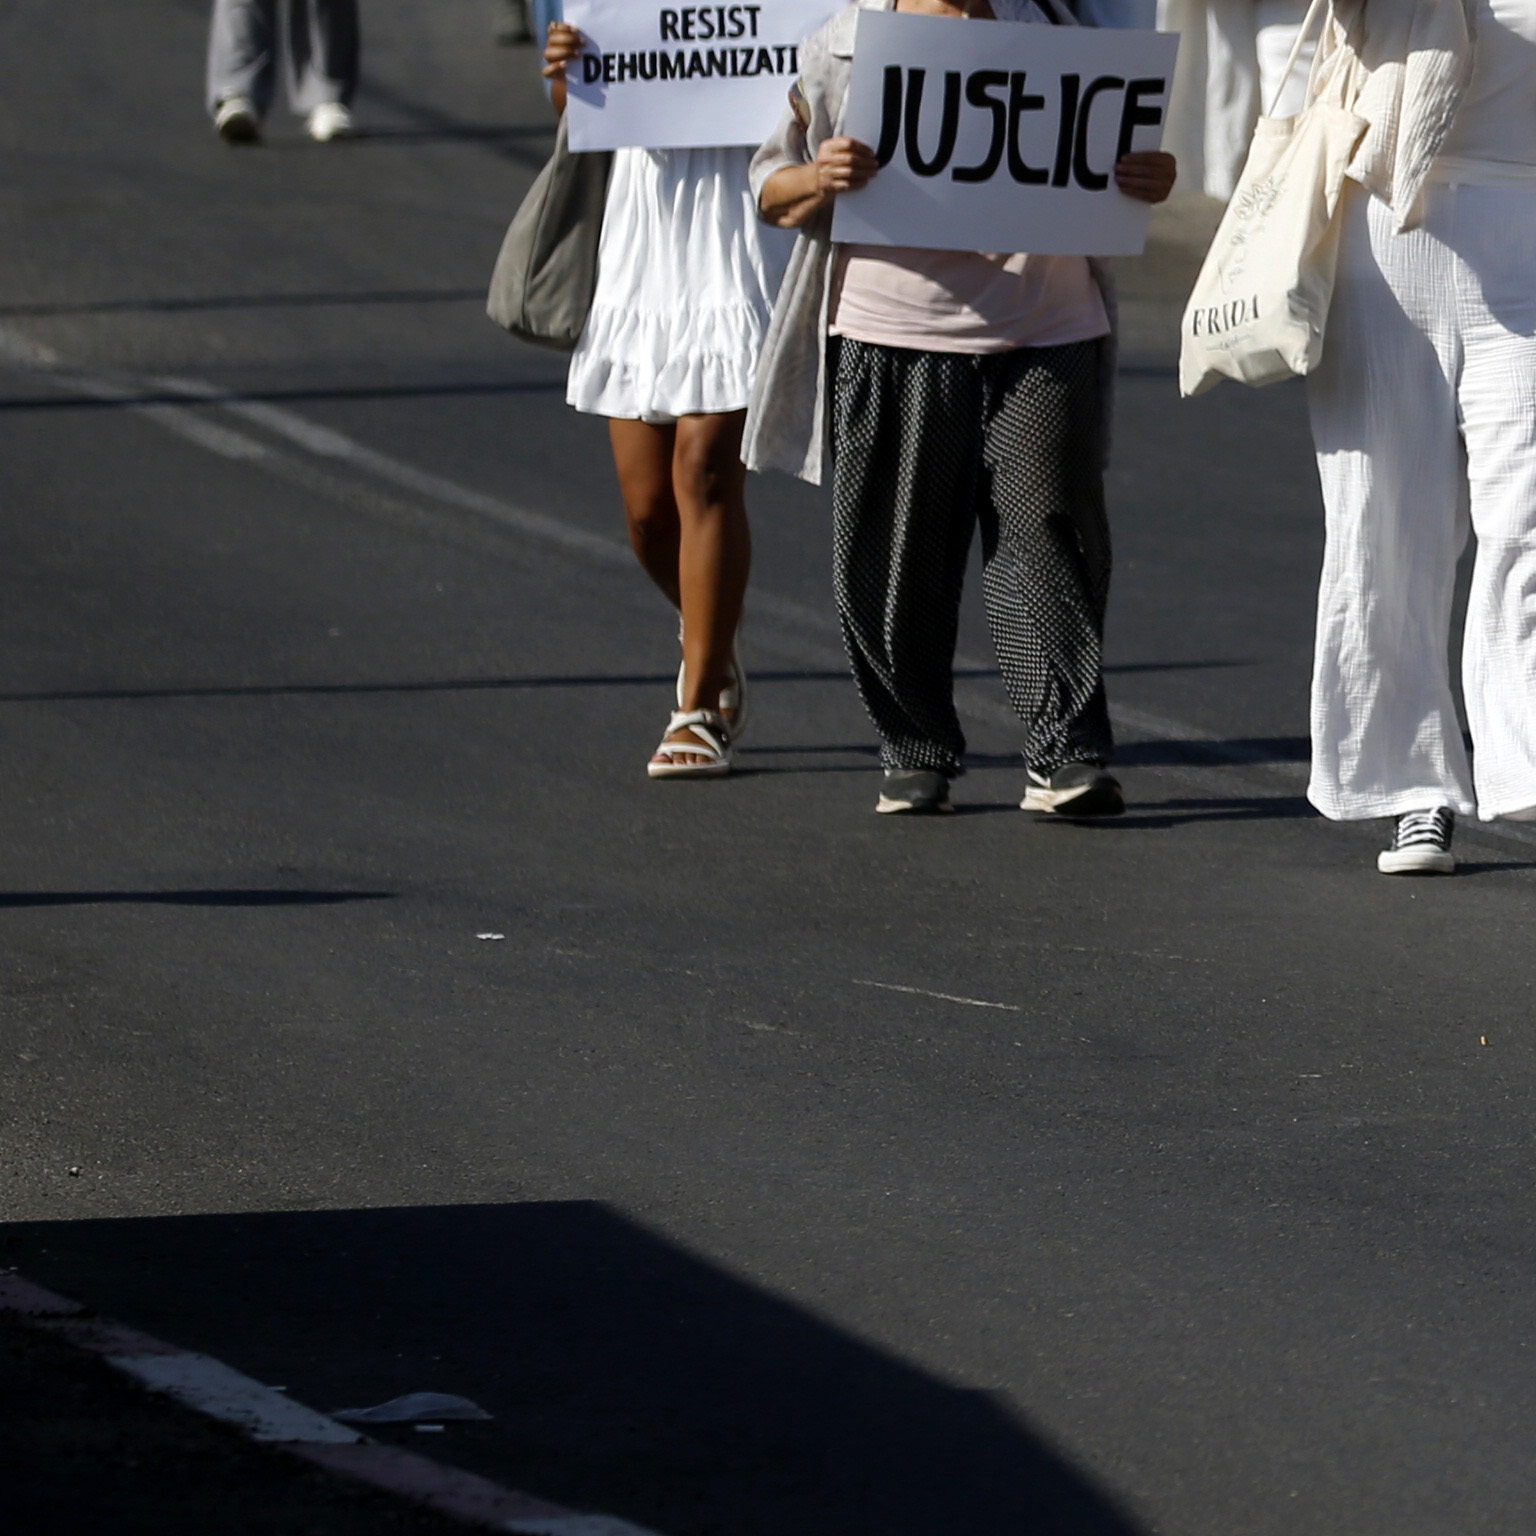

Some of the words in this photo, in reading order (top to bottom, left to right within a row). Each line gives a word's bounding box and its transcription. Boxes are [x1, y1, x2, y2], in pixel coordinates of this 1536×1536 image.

[659, 4, 761, 43] RESIST
[582, 41, 800, 85] DEHUMANIZATI
[1191, 293, 1261, 339] FRIDA
